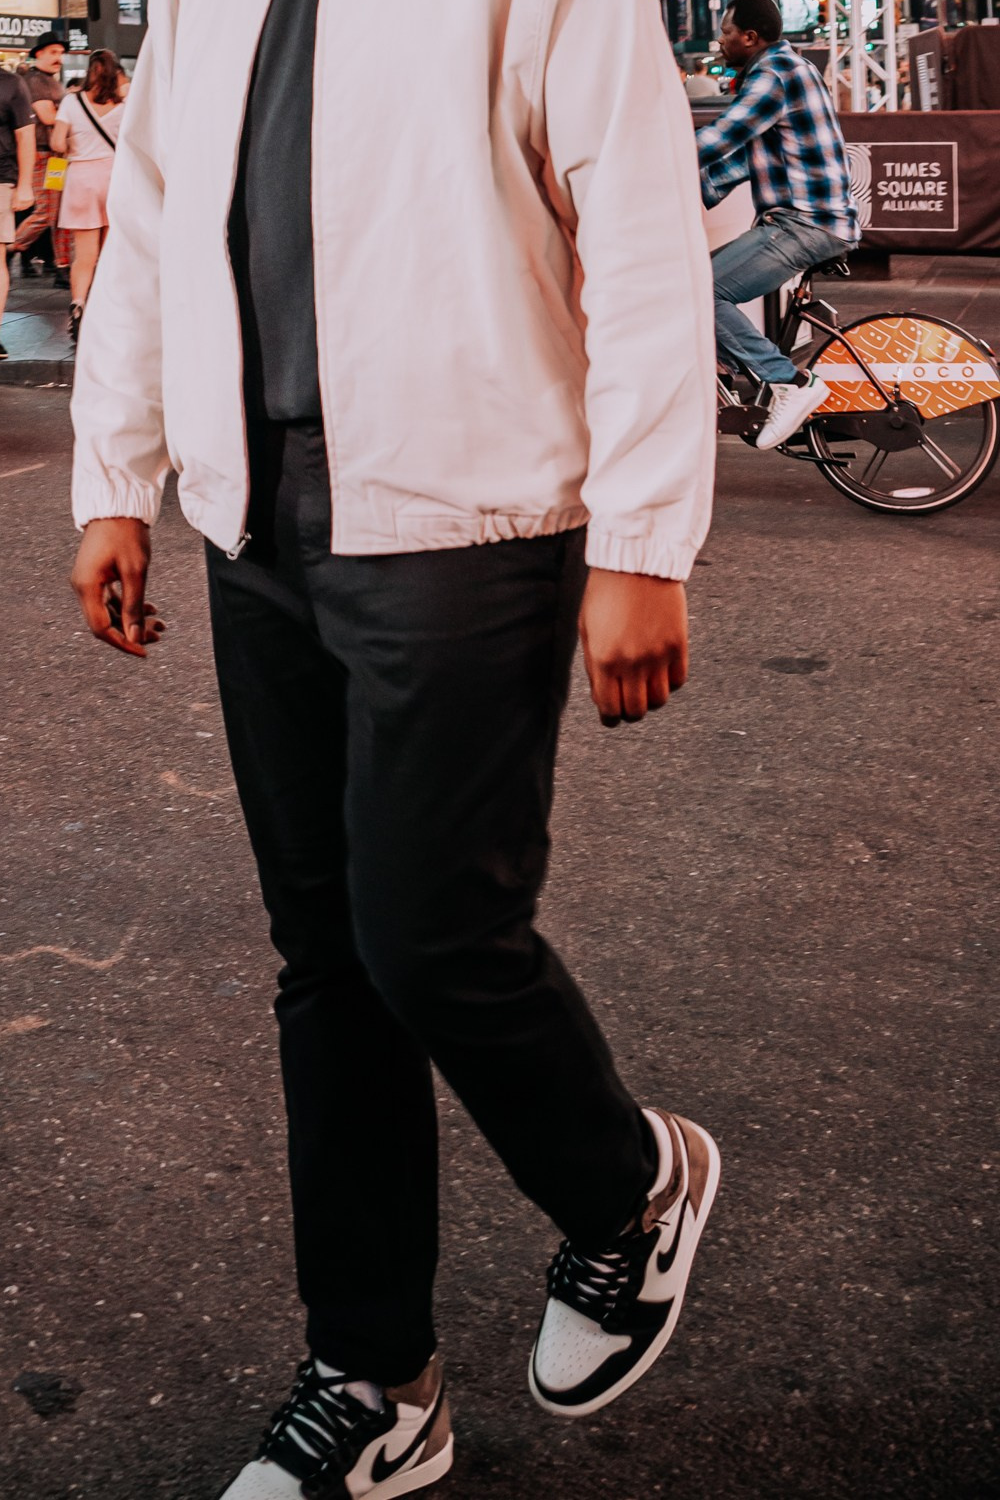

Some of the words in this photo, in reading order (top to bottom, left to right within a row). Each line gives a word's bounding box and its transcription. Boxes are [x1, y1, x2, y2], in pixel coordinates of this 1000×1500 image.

[882, 162, 941, 177] TIMES
[877, 180, 948, 198] SQUARE
[881, 199, 944, 212] ALLIANCE
